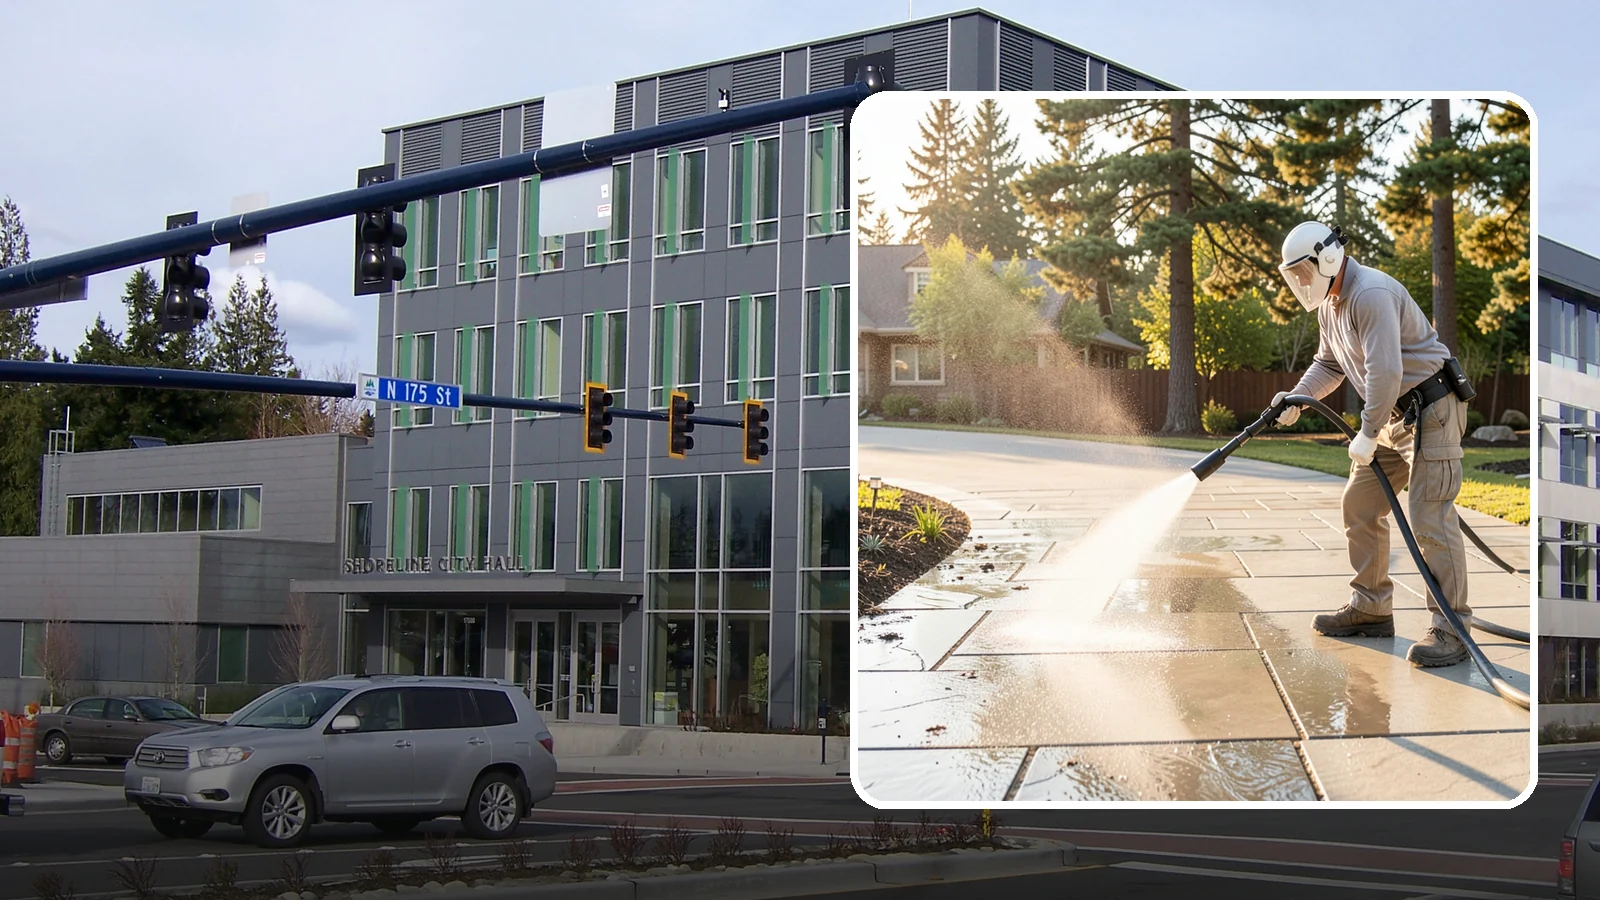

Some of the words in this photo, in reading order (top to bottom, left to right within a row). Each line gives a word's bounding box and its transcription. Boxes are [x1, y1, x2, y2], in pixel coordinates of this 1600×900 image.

[387, 380, 396, 400] N
[405, 383, 427, 403] 175
[436, 386, 451, 406] St
[343, 556, 432, 574] SHORELINE
[438, 555, 477, 573] CITY
[483, 555, 525, 572] HALL
